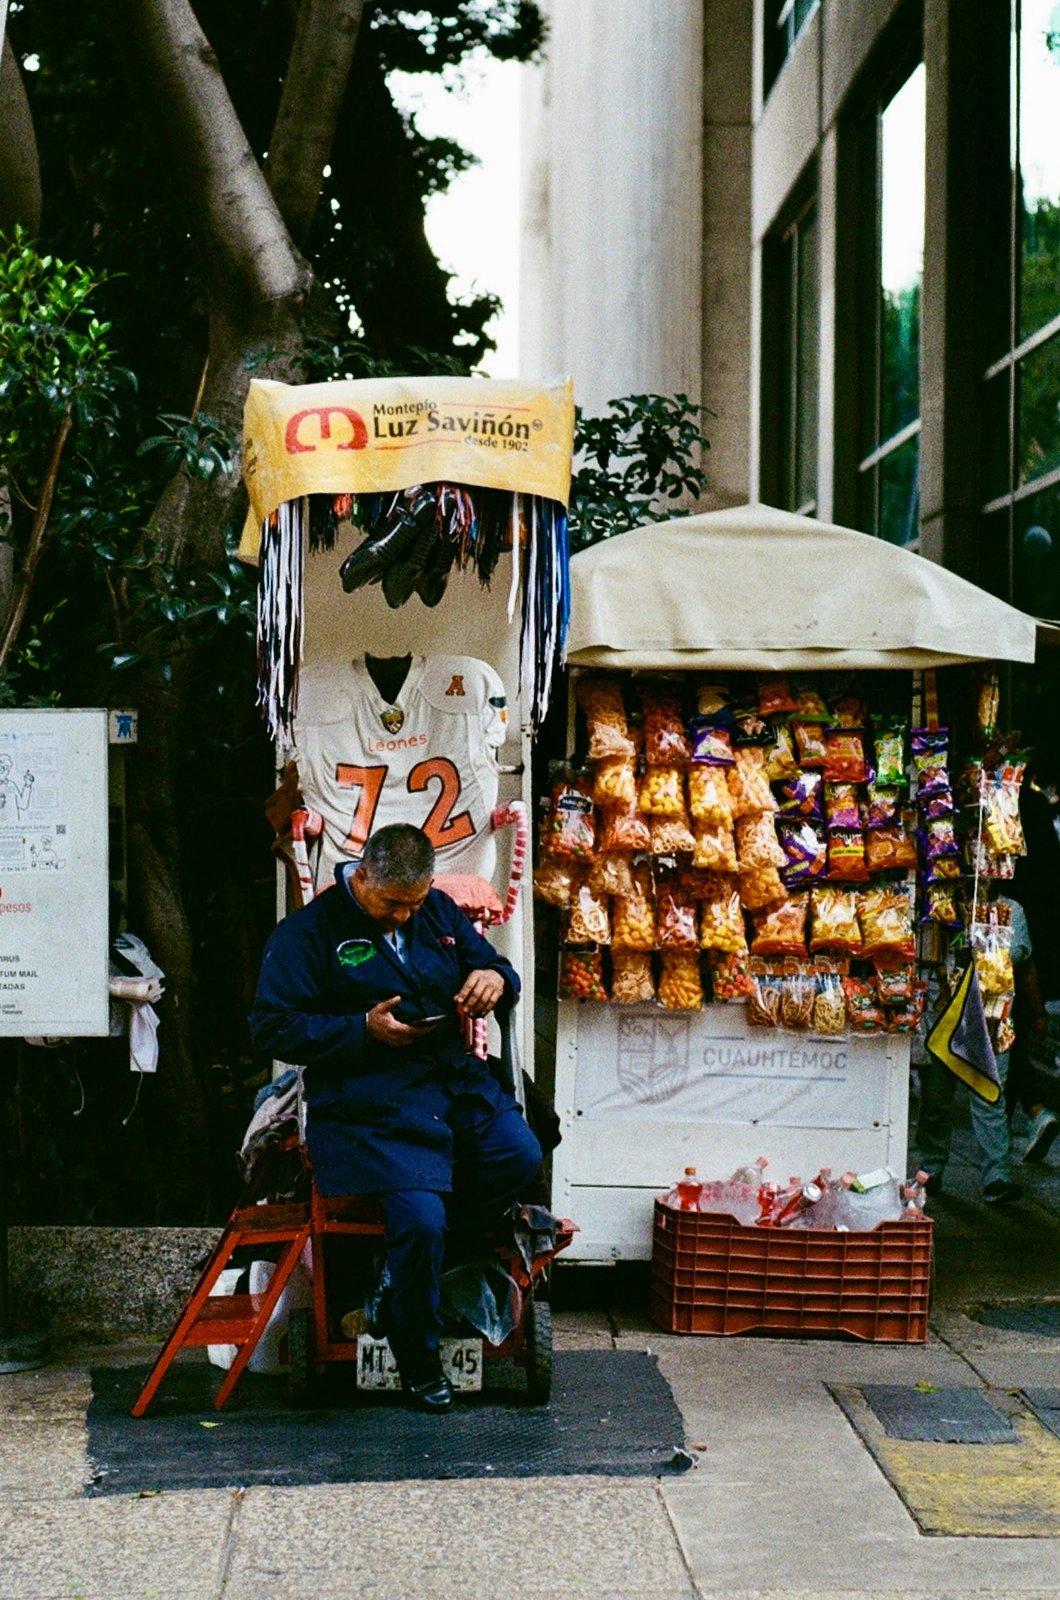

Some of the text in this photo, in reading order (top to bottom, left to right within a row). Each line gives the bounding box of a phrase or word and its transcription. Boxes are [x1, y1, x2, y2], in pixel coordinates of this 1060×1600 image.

[373, 399, 437, 416] Montepío
[374, 416, 418, 438] Luz
[427, 410, 531, 440] Saviñón
[464, 435, 529, 452] desde 1902
[444, 675, 466, 696] A
[367, 732, 429, 753] Leones
